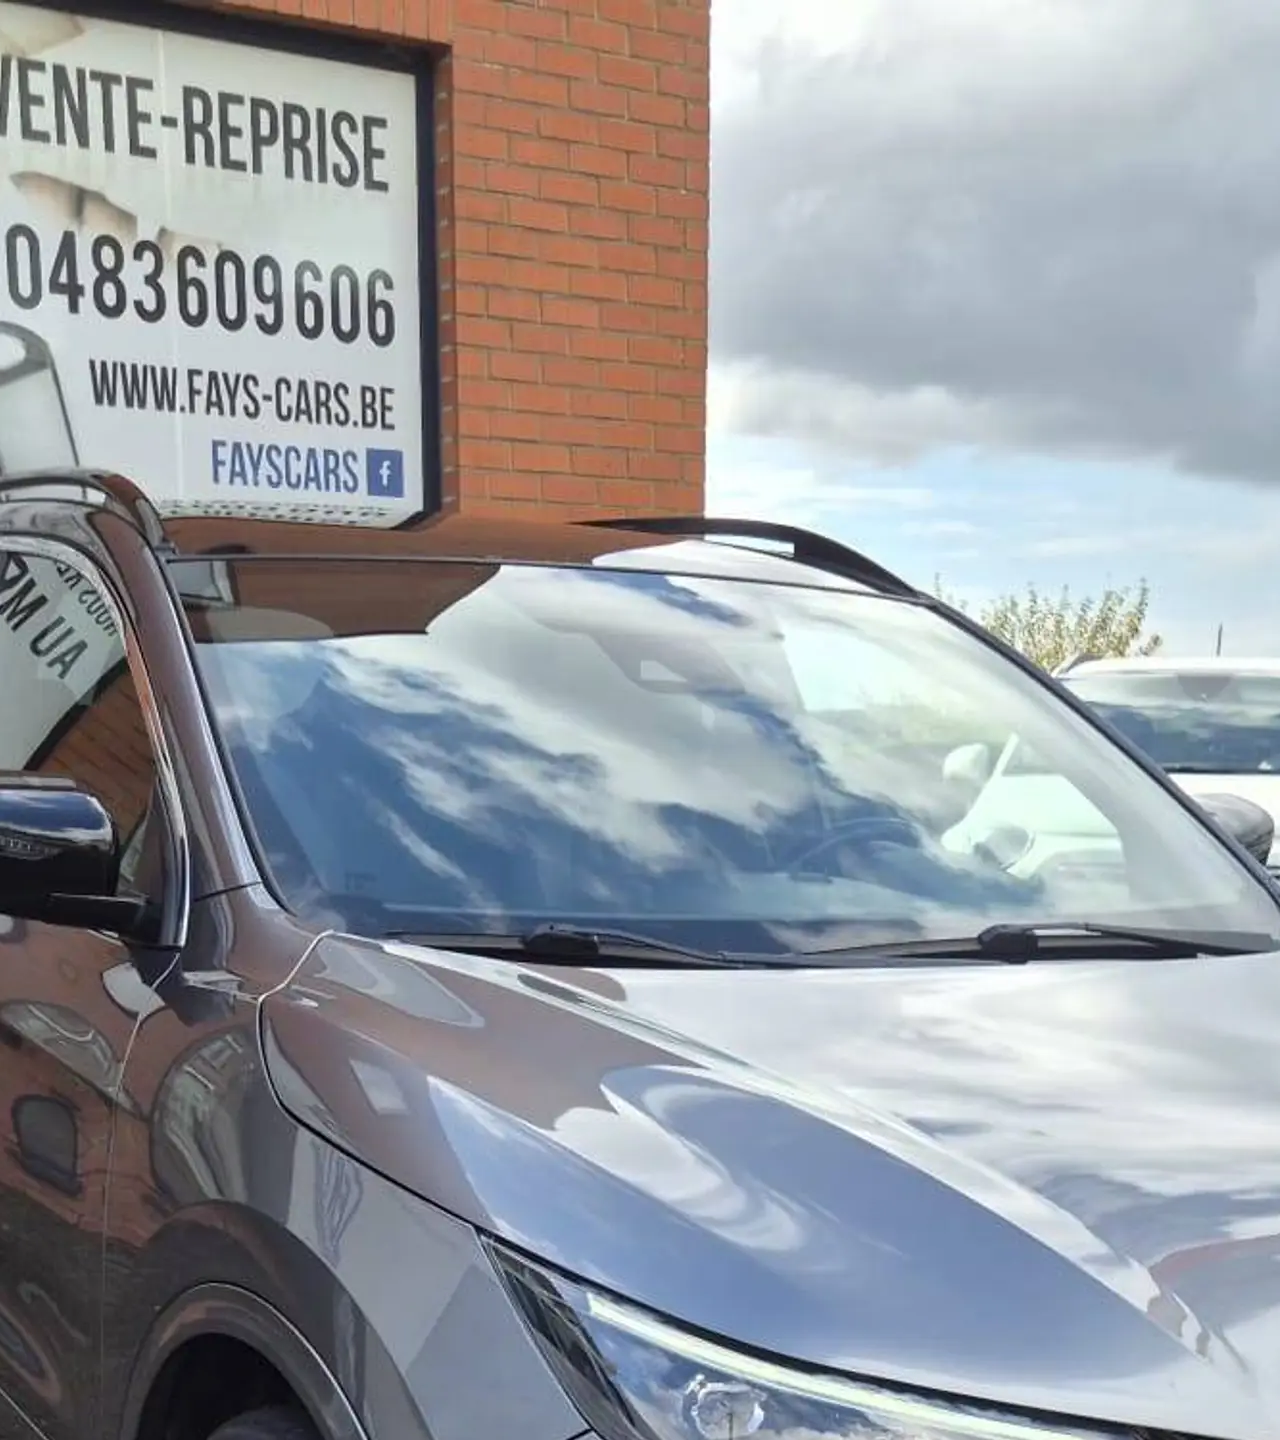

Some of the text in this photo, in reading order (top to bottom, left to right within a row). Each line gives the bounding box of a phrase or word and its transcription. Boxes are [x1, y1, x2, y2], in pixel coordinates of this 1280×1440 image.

[5, 224, 396, 346] 0483609606
[89, 359, 396, 431] WWW.FAYS-CARS.BE
[211, 439, 359, 493] FAYSCARS
